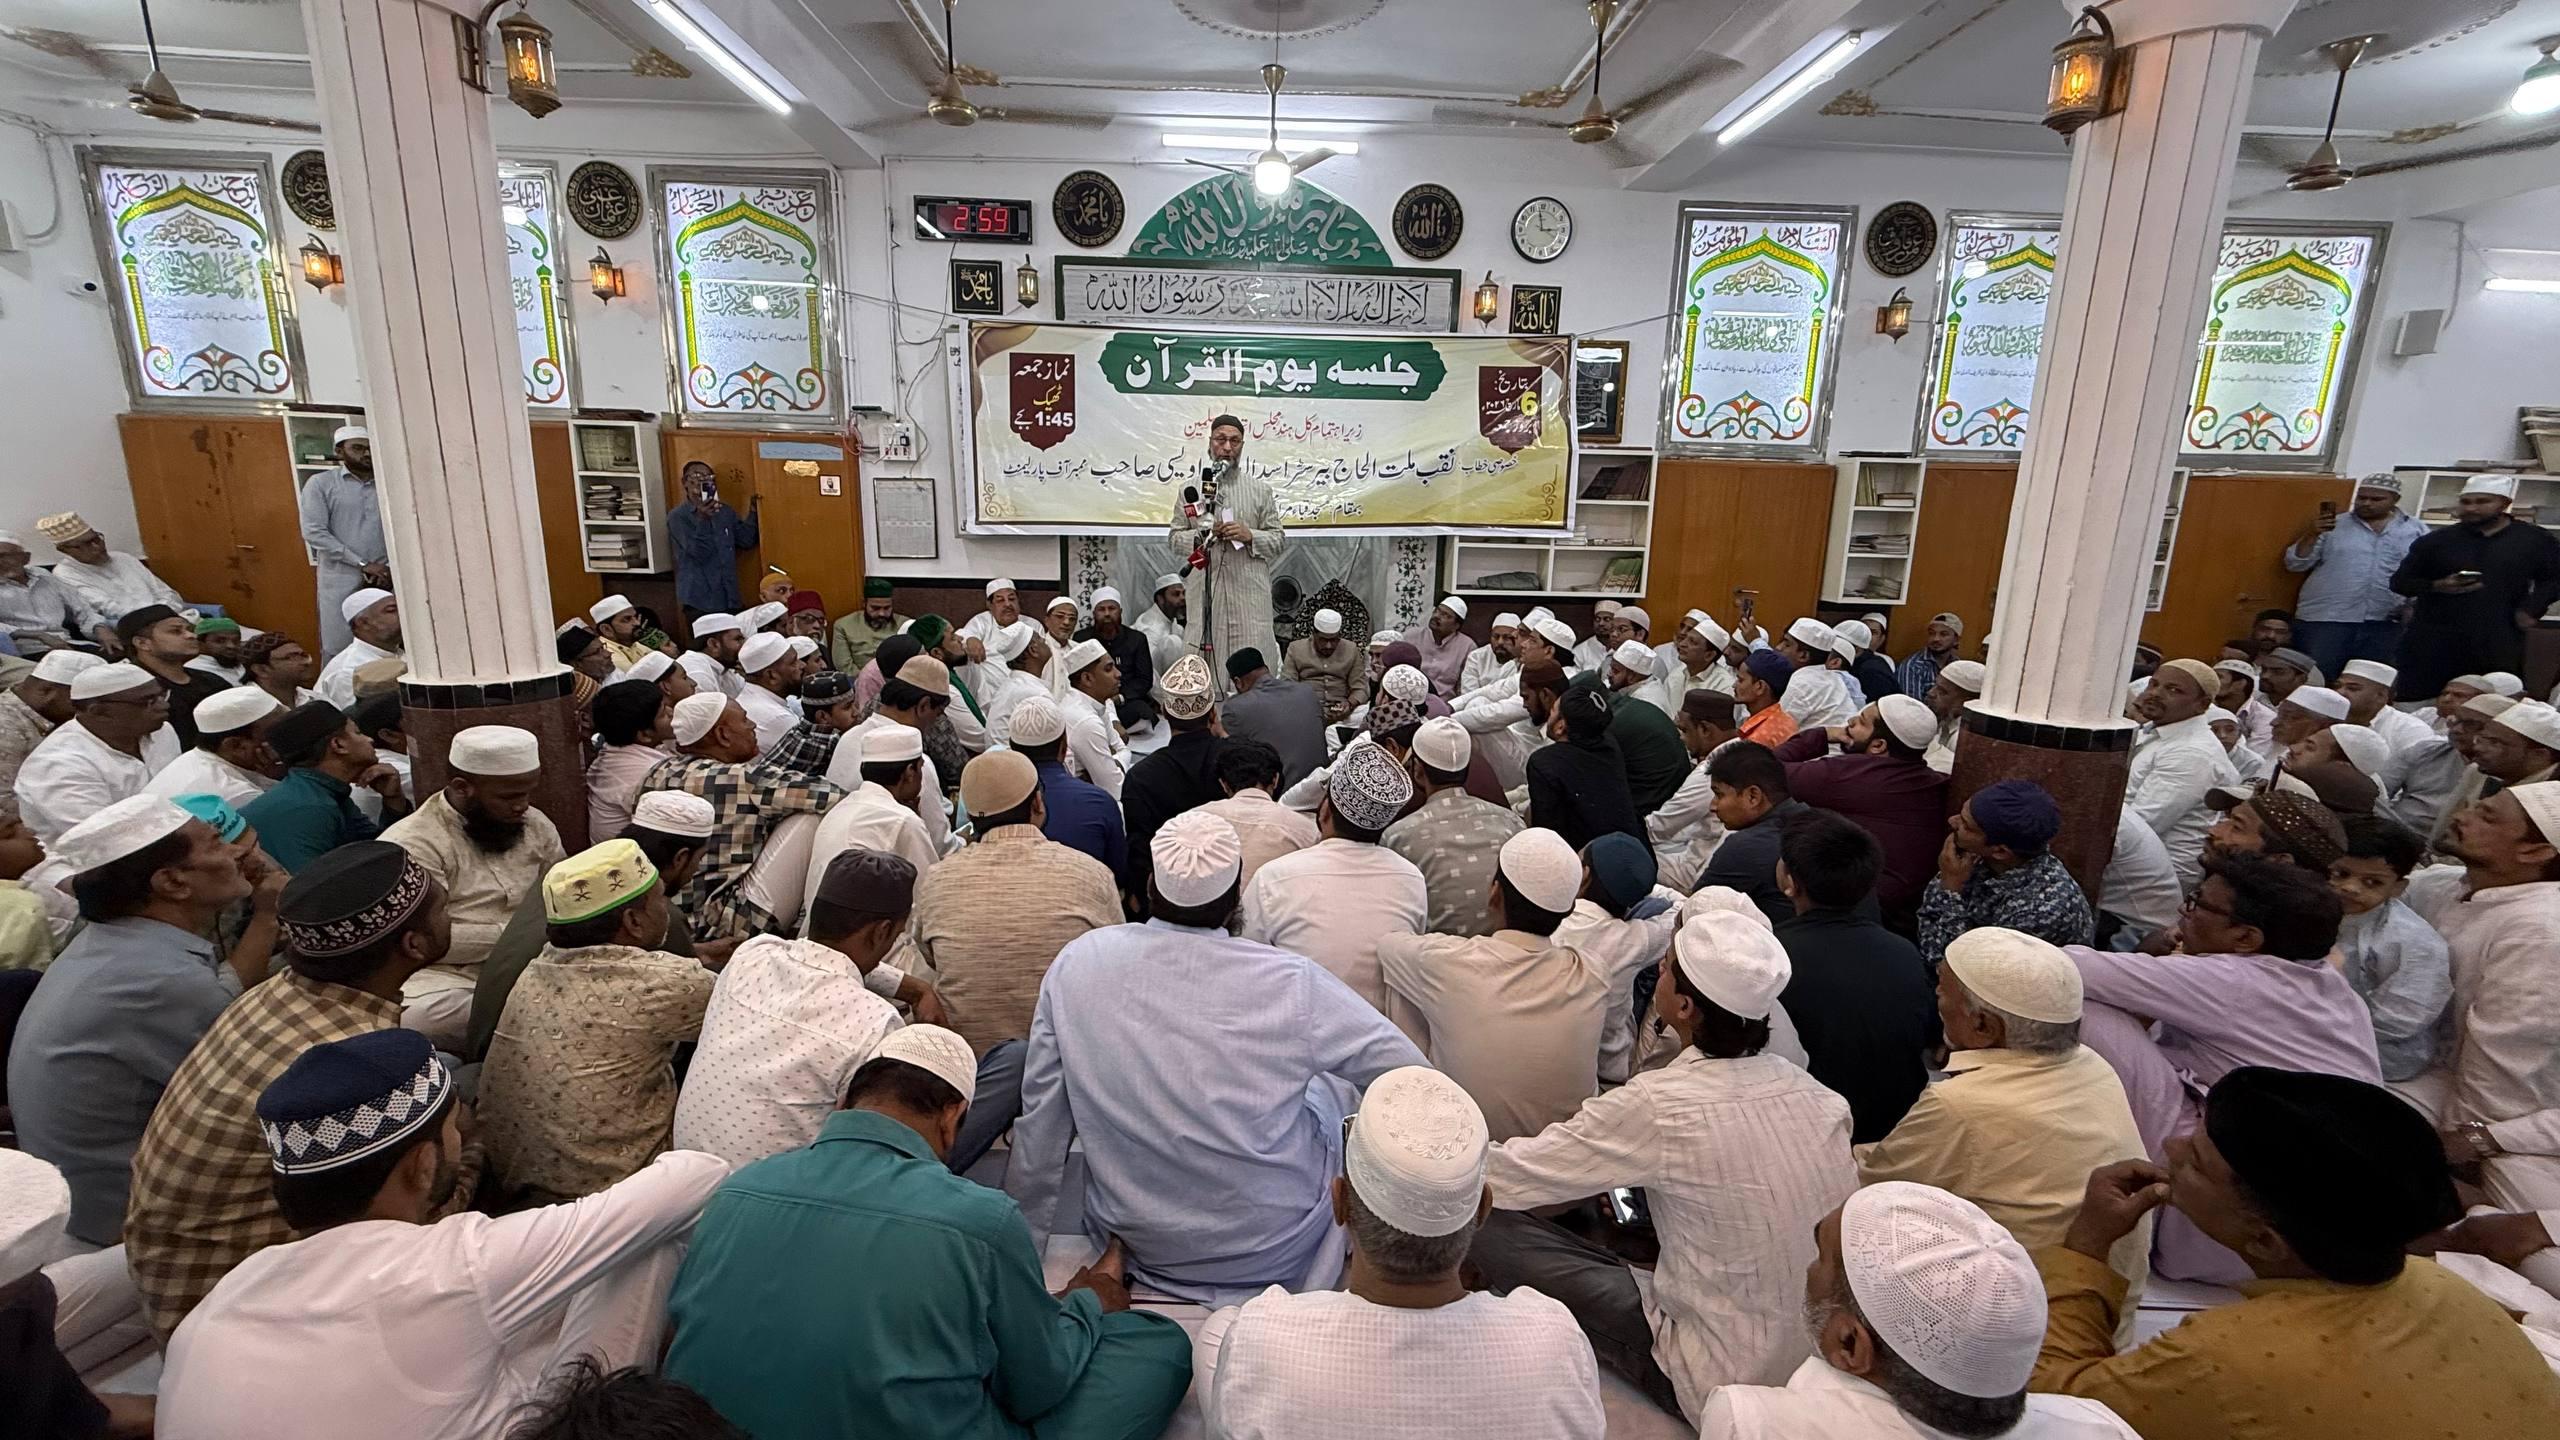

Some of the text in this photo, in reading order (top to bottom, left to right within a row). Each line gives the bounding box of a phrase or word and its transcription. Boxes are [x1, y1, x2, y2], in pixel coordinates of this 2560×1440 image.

[1014, 357, 1072, 381] نماز جمعہ
[1125, 336, 1243, 390] القرآن
[1253, 357, 1319, 396] یوم
[1520, 391, 1538, 417] 6
[1252, 410, 1283, 439] مجلس
[1090, 454, 1155, 485] صاحب
[1333, 450, 1376, 484] الحاج
[1379, 450, 1416, 479] ملت
